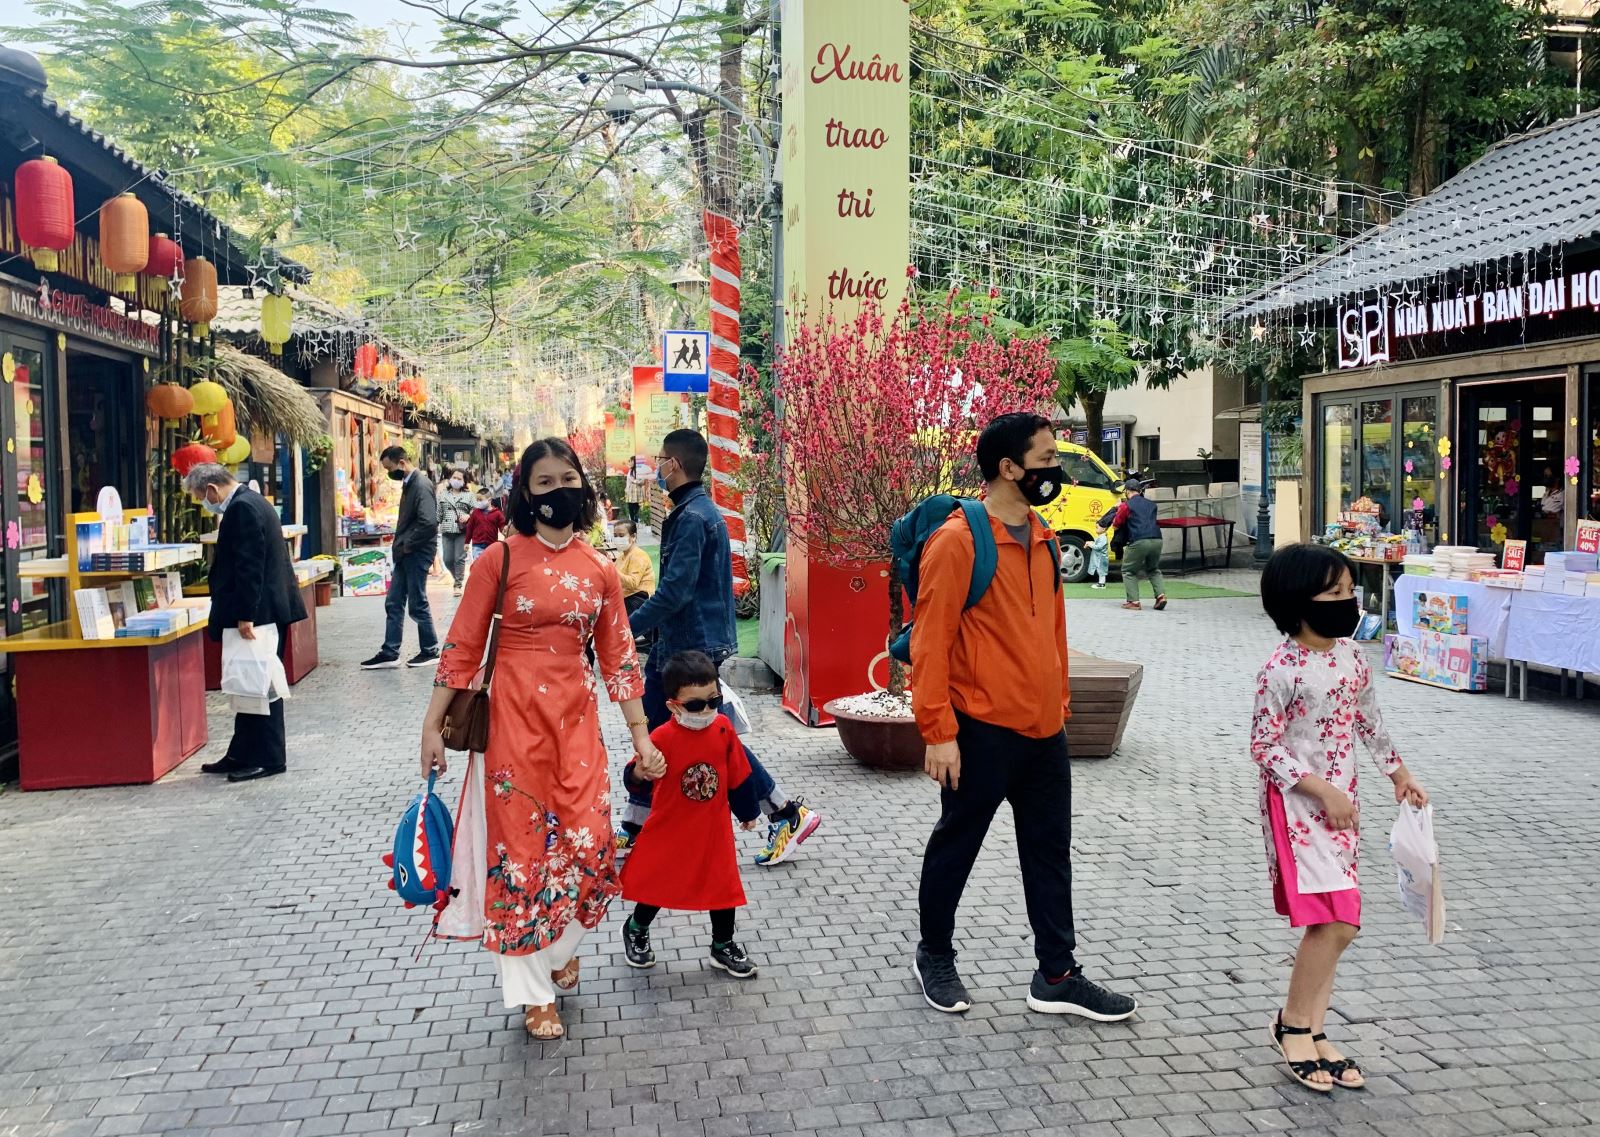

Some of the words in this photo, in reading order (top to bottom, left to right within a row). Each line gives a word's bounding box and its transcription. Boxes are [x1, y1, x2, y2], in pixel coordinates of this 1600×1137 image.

[810, 42, 903, 85] Xuân
[825, 117, 889, 150] trao
[837, 188, 875, 219] tri
[827, 267, 889, 301] thức
[1395, 300, 1429, 338] NHÀ
[1432, 287, 1477, 332] XUẤT
[1482, 281, 1523, 323] BẢN
[1528, 277, 1565, 319] ĐẠI
[1580, 541, 1595, 552] 40%
[1581, 528, 1597, 540] SALE
[1507, 548, 1521, 558] SALE
